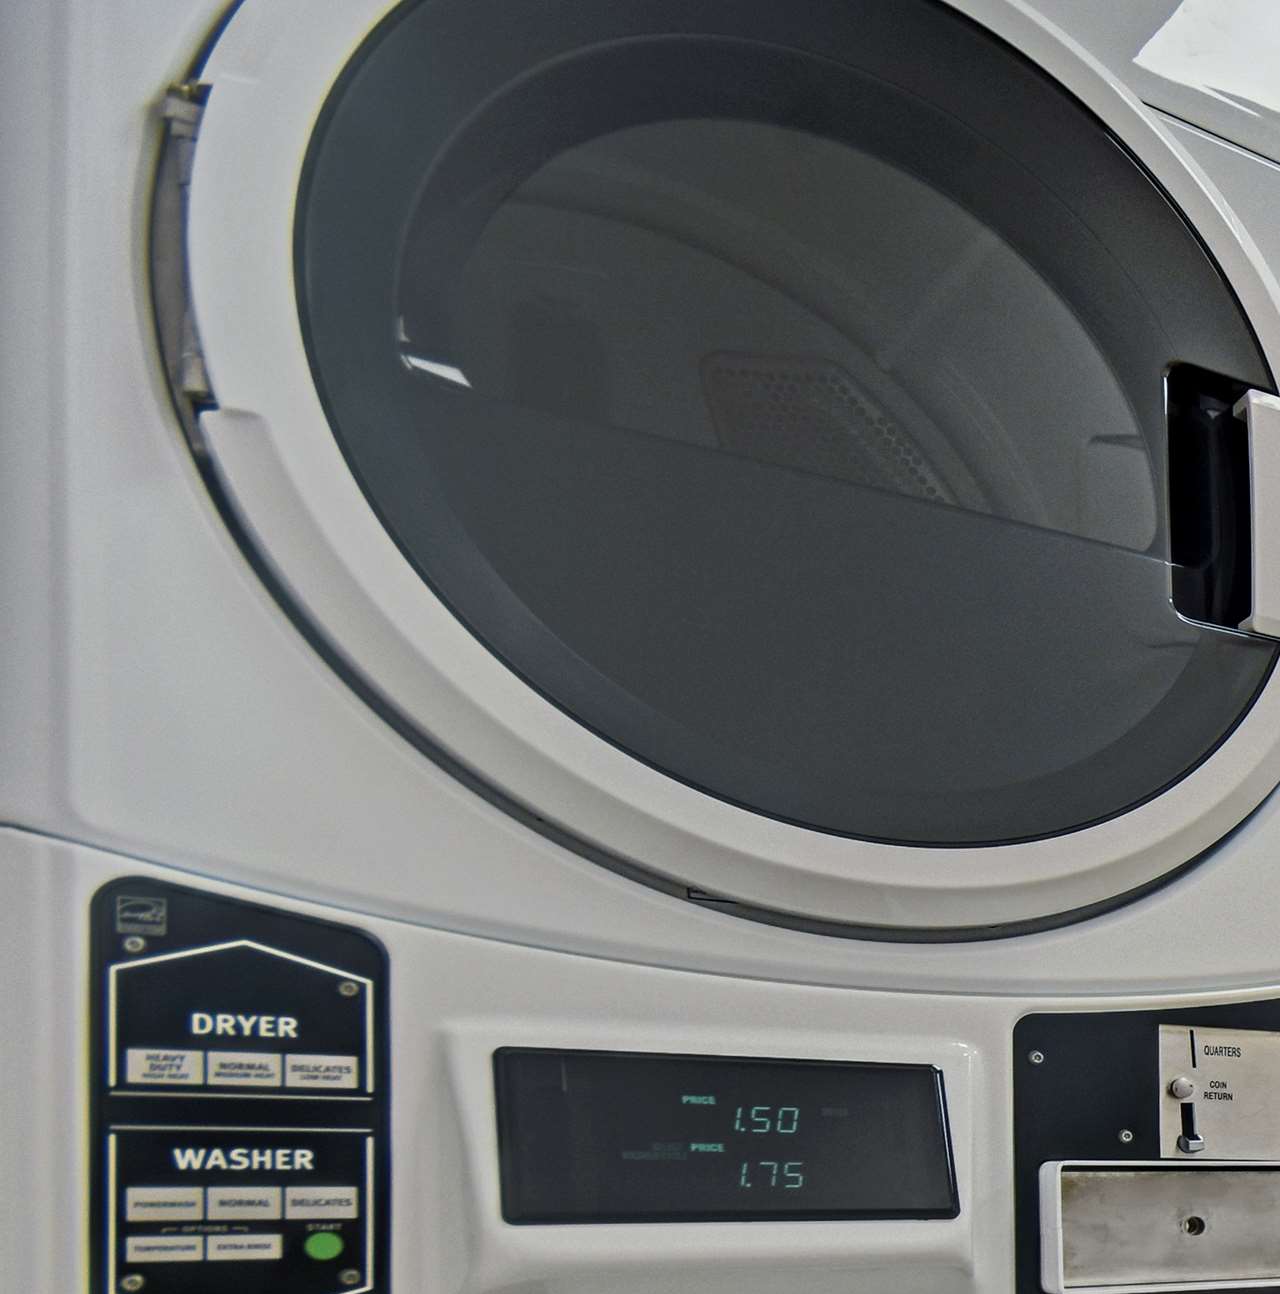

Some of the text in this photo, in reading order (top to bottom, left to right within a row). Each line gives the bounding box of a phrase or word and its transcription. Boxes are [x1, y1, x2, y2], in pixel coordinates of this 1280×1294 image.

[191, 1012, 298, 1038] DRYER
[1203, 1044, 1242, 1059] QUARTERS
[218, 1062, 271, 1071] NORMAL
[291, 1064, 352, 1074] DELICATES
[1209, 1080, 1228, 1090] COIN
[681, 1095, 717, 1104] PRICE
[1203, 1091, 1234, 1101] RETURN
[734, 1106, 800, 1134] 1.50
[690, 1143, 725, 1153] PRICE
[172, 1148, 315, 1171] WASHER
[740, 1161, 804, 1189] 1.75
